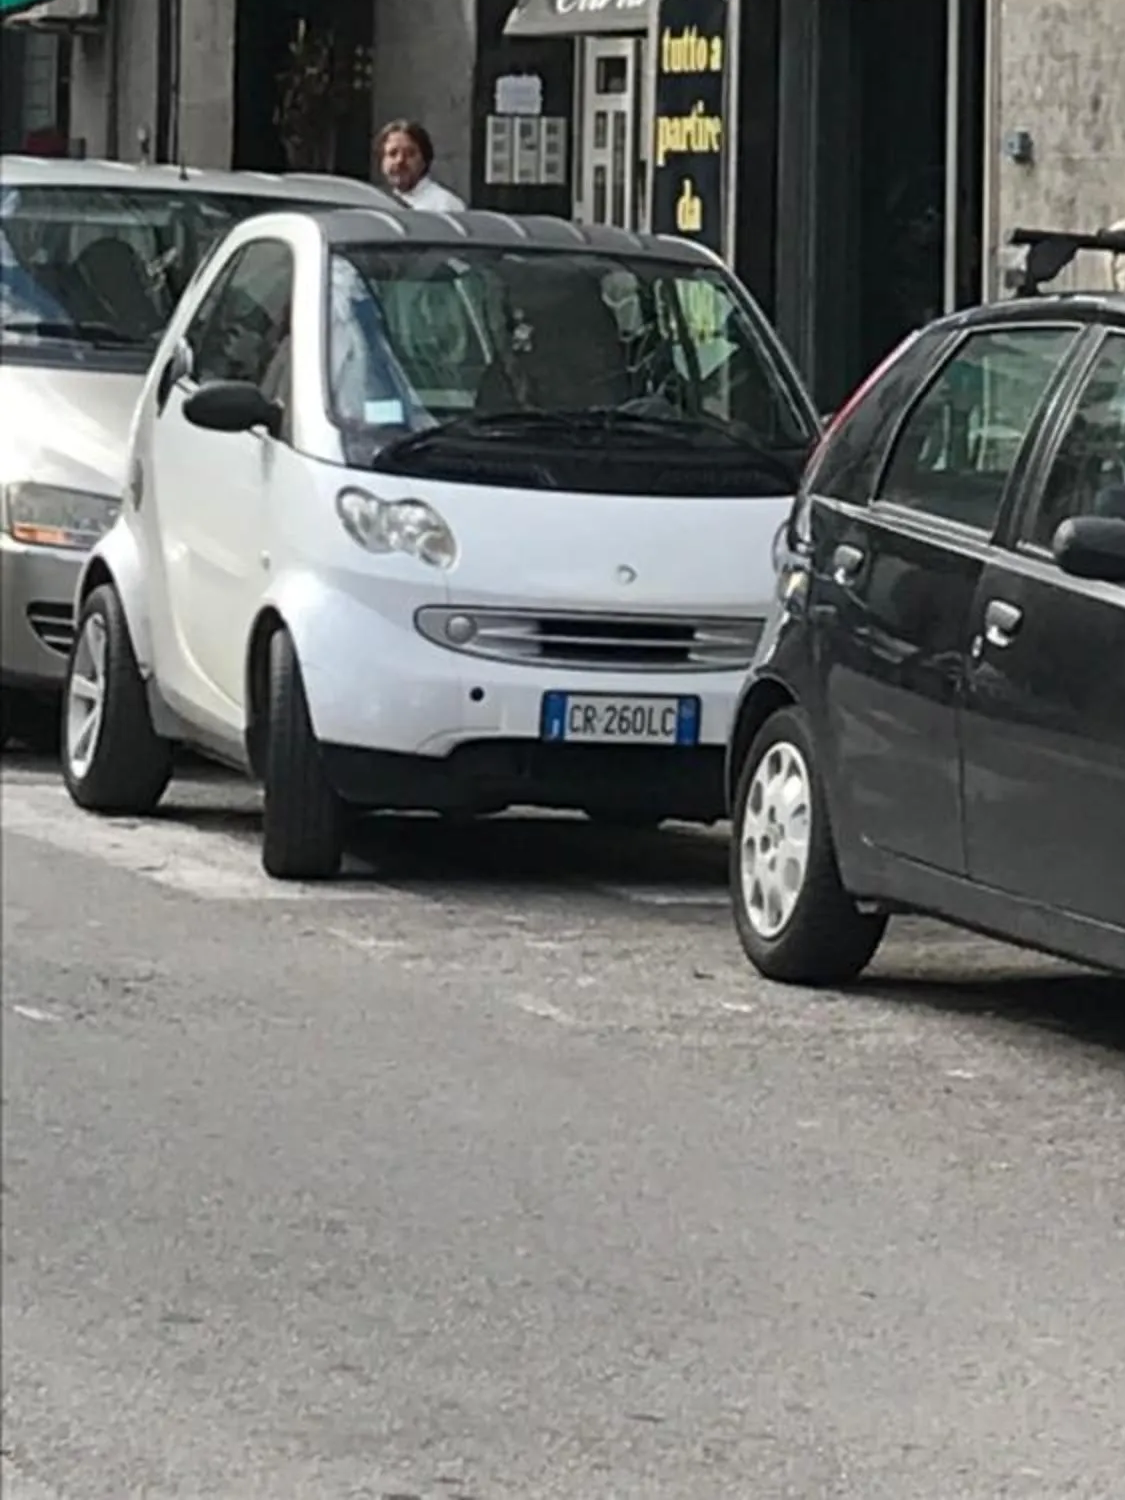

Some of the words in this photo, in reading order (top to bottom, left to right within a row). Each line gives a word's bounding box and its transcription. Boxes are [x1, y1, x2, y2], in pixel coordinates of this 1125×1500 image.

[662, 24, 708, 73] tutto
[710, 36, 722, 72] a
[656, 99, 722, 167] partire
[676, 179, 702, 231] da
[569, 704, 598, 735] CR
[603, 705, 677, 737] 260LC
